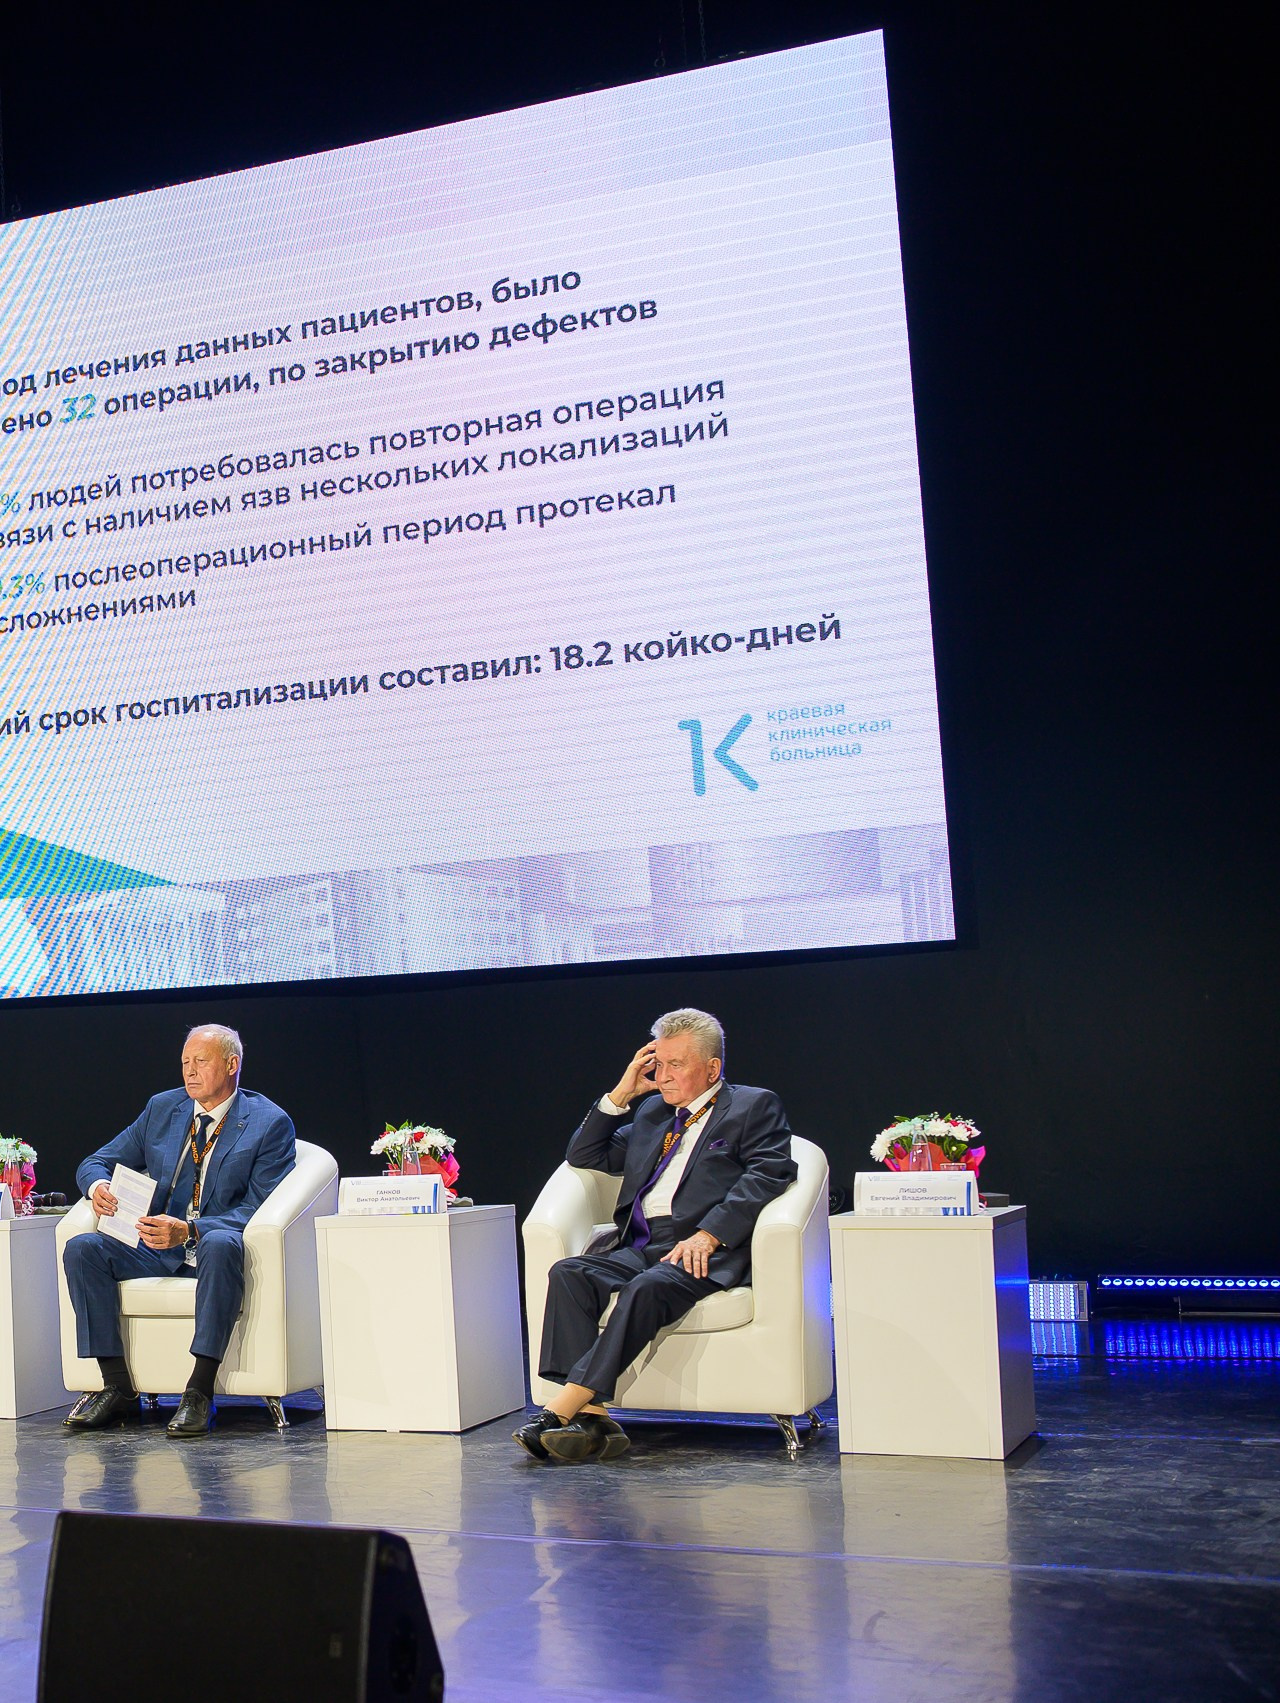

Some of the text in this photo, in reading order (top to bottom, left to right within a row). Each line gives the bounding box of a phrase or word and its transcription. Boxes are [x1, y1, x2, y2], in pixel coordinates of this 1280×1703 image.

[44, 349, 166, 389] лечения
[175, 323, 292, 366] данных
[301, 291, 482, 339] пациентов,
[492, 271, 581, 303] было
[59, 393, 97, 424] 32
[104, 372, 260, 415] операции,
[269, 363, 306, 386] по
[315, 332, 480, 378] закрытию
[489, 299, 658, 350] дефектов
[28, 474, 121, 511] людей
[131, 441, 360, 493] потребовалась
[369, 409, 542, 455] повторная
[553, 380, 725, 424] операция
[62, 520, 77, 538] с
[85, 496, 231, 535] наличием
[241, 486, 291, 511] язв
[300, 455, 488, 501] нескольких
[497, 413, 729, 472] локализаций
[54, 522, 372, 592] послеоперационный
[383, 509, 507, 544] период
[516, 484, 677, 528] протекал
[39, 705, 107, 735] срок
[116, 675, 369, 723] госпитализации
[379, 653, 542, 691] составил:
[550, 641, 613, 671] 18.2
[624, 613, 842, 664] койко-дней
[767, 702, 846, 723] краевая
[769, 717, 892, 742] клиническая
[770, 741, 863, 762] больница
[901, 1194, 957, 1202] Владимирович
